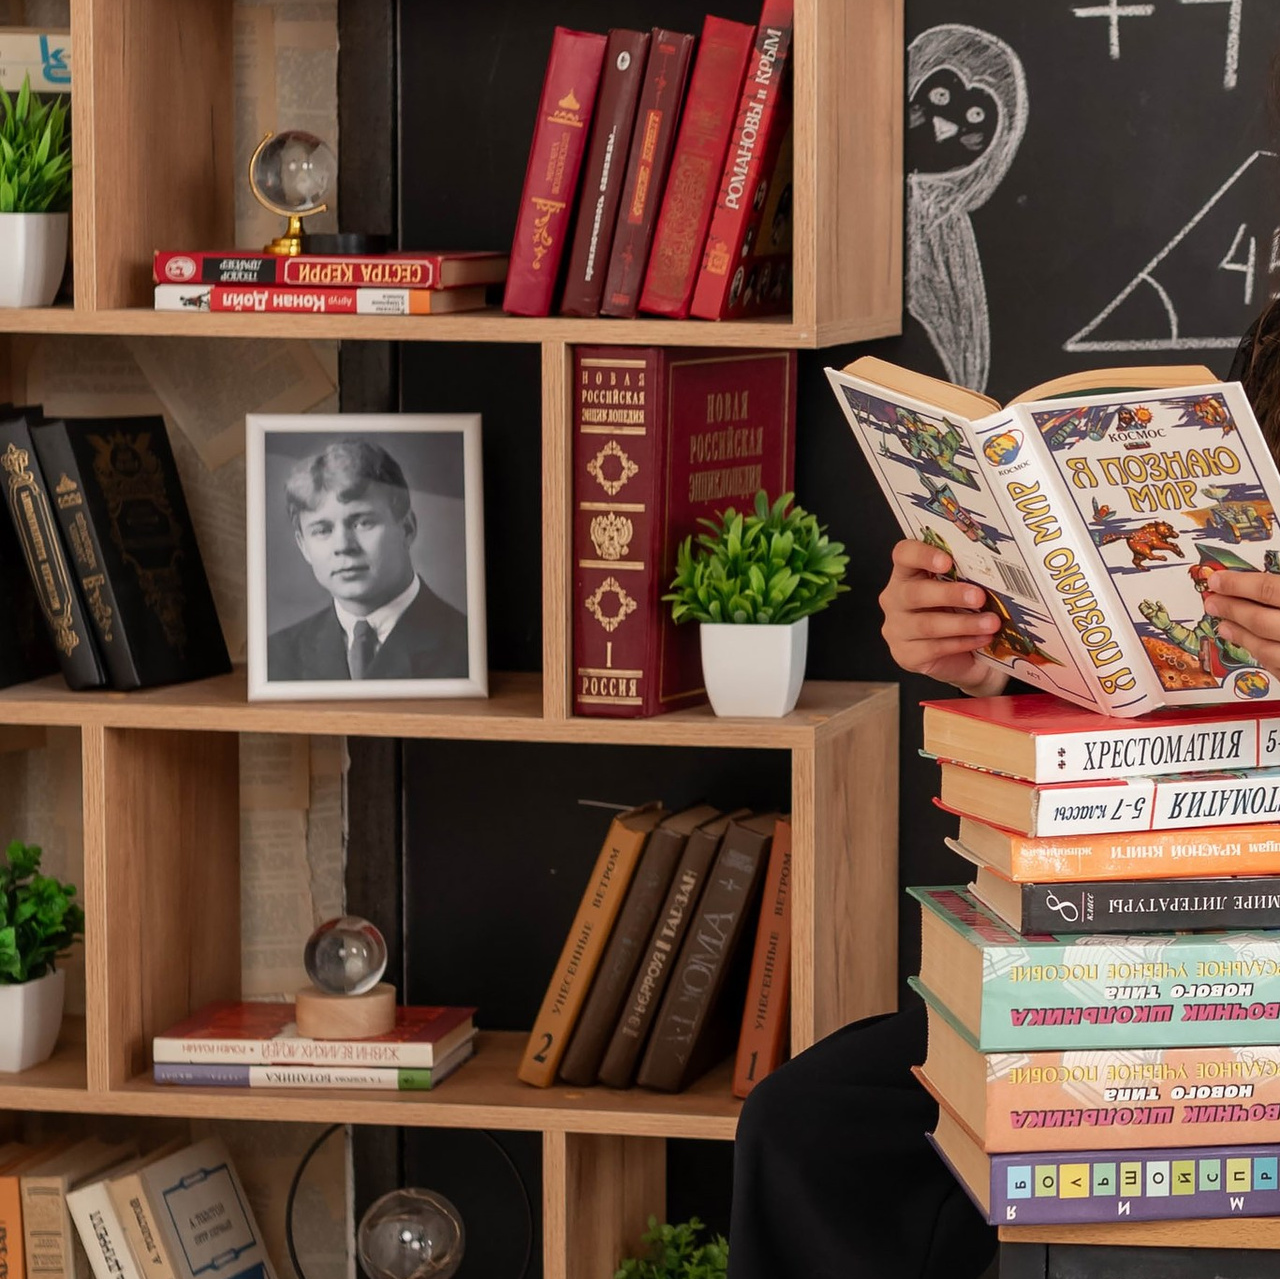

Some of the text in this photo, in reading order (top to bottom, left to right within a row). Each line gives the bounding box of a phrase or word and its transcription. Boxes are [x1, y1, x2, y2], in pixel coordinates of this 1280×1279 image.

[725, 102, 763, 210] РОМАНОВЫ
[755, 28, 782, 85] КРЫМ
[299, 262, 421, 283] СЕСТРА КЕРРИ
[222, 292, 352, 312] Артур Конан Дойл
[582, 372, 645, 387] НОВАЯ
[582, 389, 645, 405] РОССИЙСКАЯ
[582, 408, 645, 424] ЭНЦИКЛОПЕДИЯ
[706, 390, 749, 424] НОВАЯ
[689, 426, 763, 464] РОССИЙСКАЯ
[1108, 428, 1167, 443] КОСМОС
[998, 459, 1031, 477] КОСМОС
[1066, 445, 1243, 490] Я ПОЗНАЮ
[688, 465, 763, 504] ЭНЦИКЛОПЕДИЯ
[1123, 480, 1198, 513] МИР
[1006, 479, 1137, 695] Я ПОЗНАЮ МИР
[583, 677, 637, 697] РОССИЯ
[1082, 730, 1244, 771] ХРЕСТОМАТИЯ
[1054, 803, 1108, 822] классы
[1110, 796, 1146, 820] 5-7
[1111, 844, 1163, 859] КНИГИ
[1171, 844, 1241, 860] КРАСНОЙ
[1046, 890, 1079, 922] 8
[1086, 892, 1096, 922] класс
[1108, 896, 1229, 914] ЛИТЕРАТУРЫ
[1234, 894, 1280, 910] МИРЕ
[552, 847, 622, 1015] УНЕСЕННЫЕ ВЕТРОМ
[755, 852, 793, 1030] УНЕСЕННЫЕ ВЕТРОМ
[1008, 964, 1098, 983] ПОСОБИЕ
[1107, 962, 1188, 980] УЧЕБНОЕ
[1103, 983, 1254, 1000] нового типа
[1010, 1004, 1174, 1027] ШКОЛЬНИКА
[261, 1043, 301, 1059] ЛЮДЕЙ
[302, 1045, 353, 1060] ВЕЛИКИХ
[356, 1046, 400, 1060] ЖИЗНИ
[533, 1033, 554, 1064] 2
[745, 1050, 758, 1081] 1
[1008, 1065, 1098, 1084] ПОСОБИЕ
[1107, 1062, 1188, 1081] УЧЕБНОЕ
[264, 1072, 332, 1083] БОТАНИКА
[1103, 1084, 1254, 1101] нового типа
[1010, 1106, 1174, 1129] ШКОЛЬНИКА
